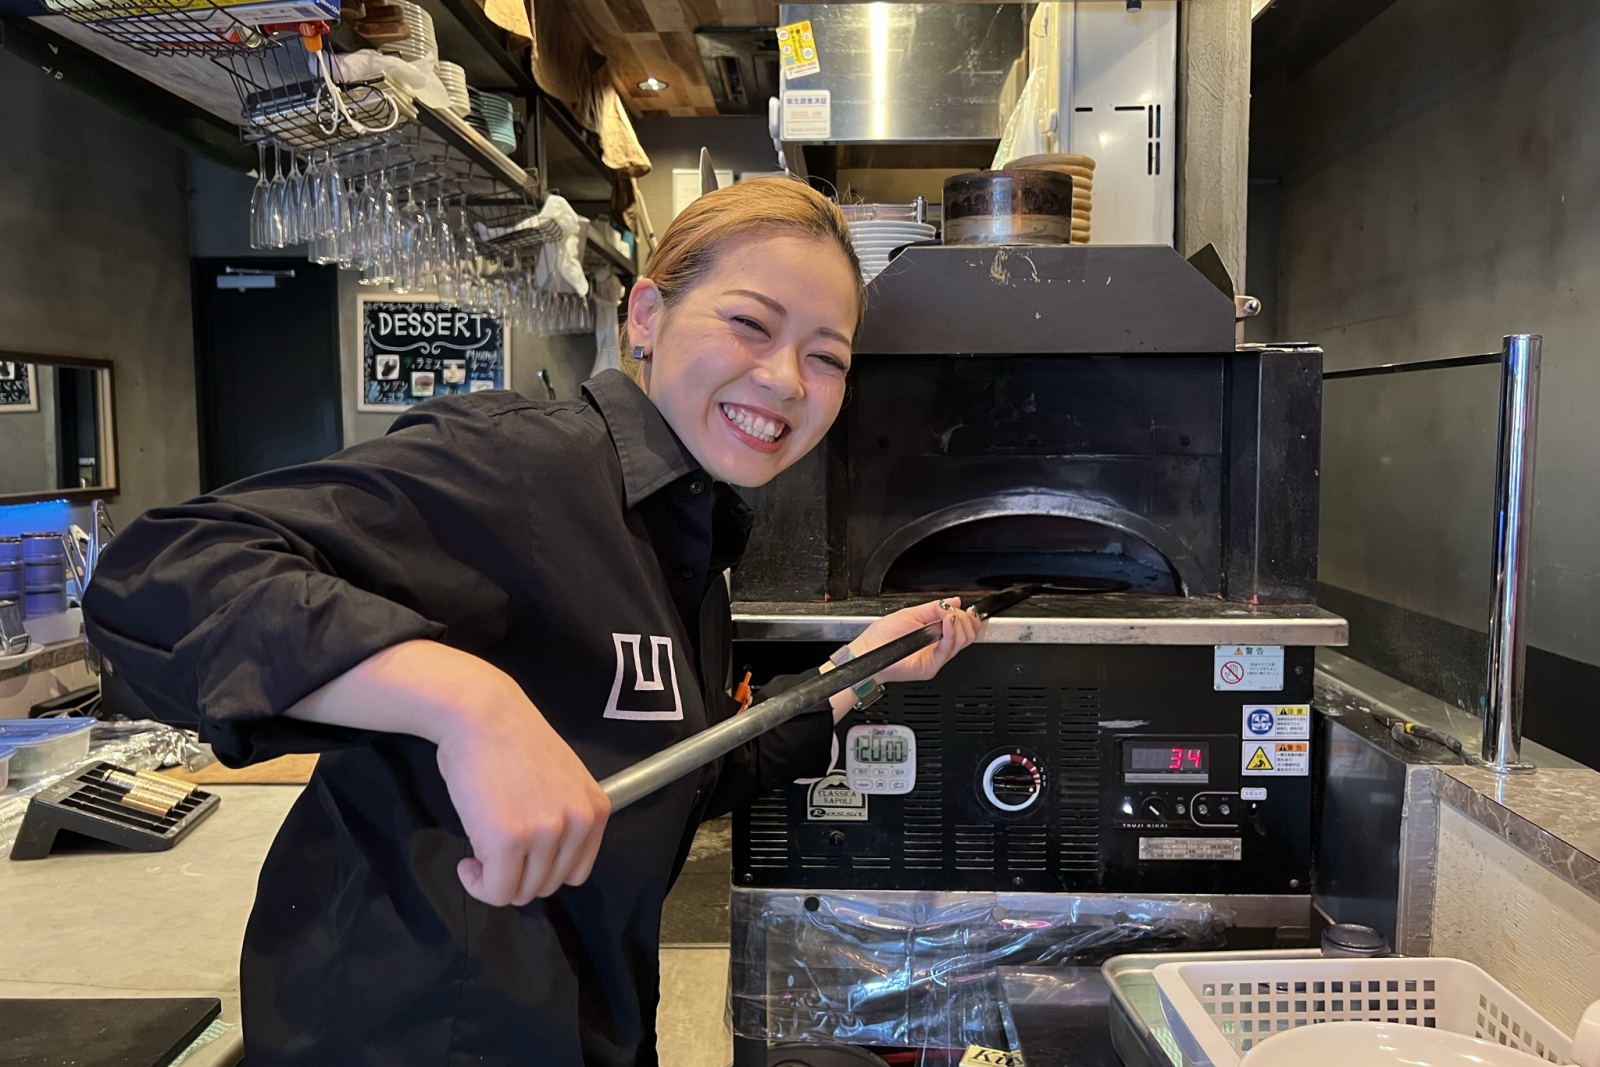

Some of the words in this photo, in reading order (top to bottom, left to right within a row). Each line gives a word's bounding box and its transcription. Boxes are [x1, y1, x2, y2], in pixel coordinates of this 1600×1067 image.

[378, 312, 482, 338] DESSERT
[1246, 647, 1264, 655] 警告
[1169, 748, 1201, 769] 34
[811, 809, 865, 818] Rossa
